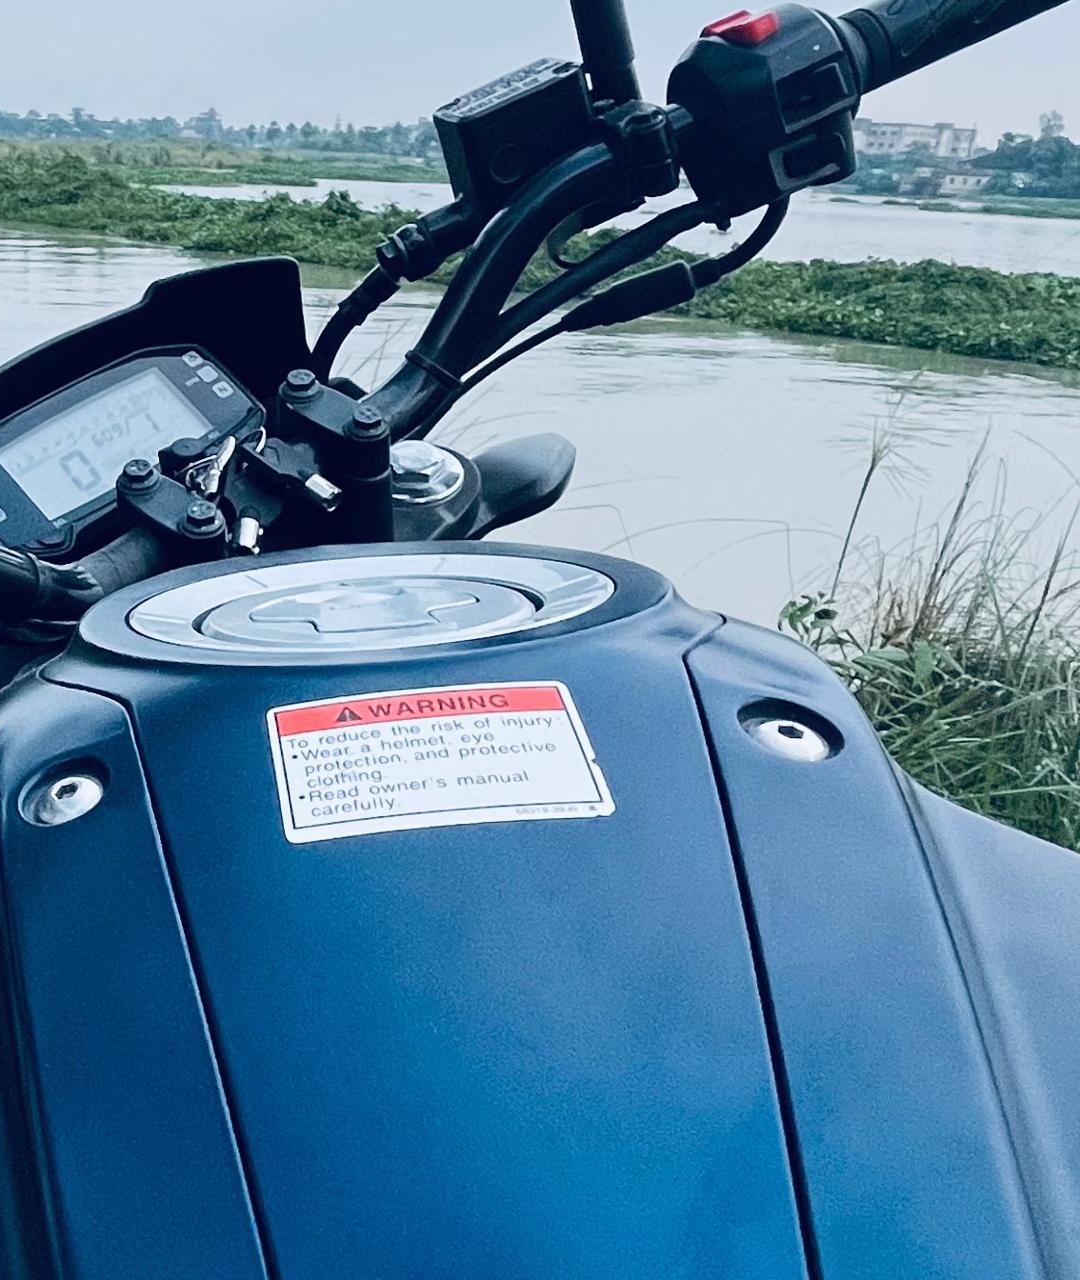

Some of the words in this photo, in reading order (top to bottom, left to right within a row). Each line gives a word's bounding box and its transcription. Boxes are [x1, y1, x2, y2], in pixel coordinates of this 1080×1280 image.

[368, 694, 510, 718] WARNING
[288, 738, 309, 750] To
[319, 729, 381, 745] reduce
[392, 723, 421, 736] the
[431, 719, 464, 732] risk
[474, 716, 491, 729] of
[301, 747, 350, 761] Wear
[360, 744, 371, 753] a
[461, 731, 495, 745] eye
[414, 747, 450, 762] and
[459, 741, 557, 759] protective
[309, 785, 359, 803] Read
[369, 777, 447, 795] owner's
[457, 771, 530, 787] manual
